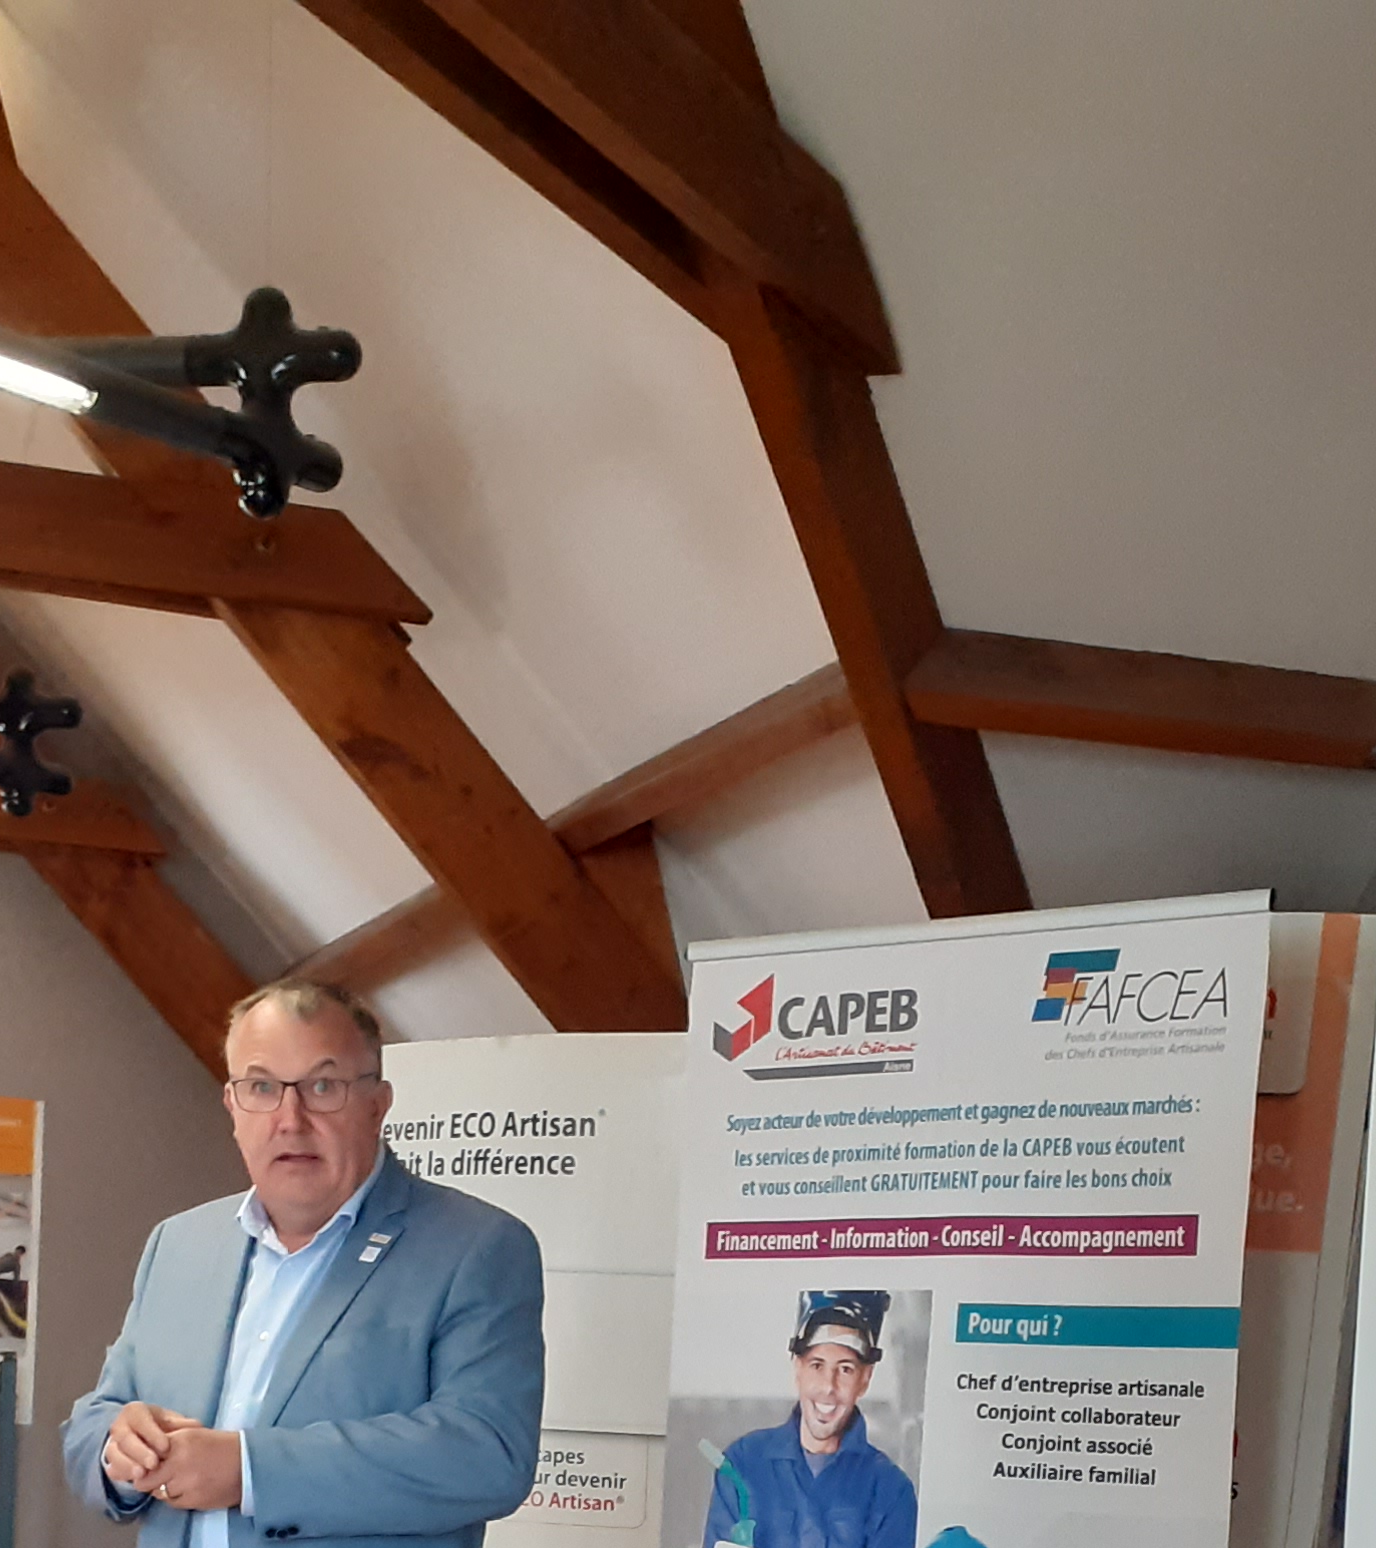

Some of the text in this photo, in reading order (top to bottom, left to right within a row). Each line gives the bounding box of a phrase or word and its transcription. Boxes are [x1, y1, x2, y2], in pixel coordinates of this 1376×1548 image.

[1064, 967, 1227, 1026] FAFCEA
[778, 989, 919, 1040] CAPEB
[1168, 1026, 1226, 1038] Formation
[1168, 1042, 1225, 1054] Artisanale
[383, 1112, 496, 1143] evenir ECO
[727, 1095, 1193, 1135] Soyez acteur de votre développement et gagnez de nouveaux marchés
[427, 1150, 445, 1176] la
[451, 1148, 576, 1176] différence
[735, 1136, 1185, 1167] les services de proximité formation de la CAPEB vous écoutent
[741, 1167, 1173, 1196] et vous conseillent GRATUITEMENT pour faire les bons choix
[717, 1224, 1186, 1253] Financement Information Conseil Accompagnement
[968, 1311, 1048, 1342] Pour qui
[956, 1373, 998, 1391] Chef
[1117, 1379, 1205, 1399] artisanale
[976, 1403, 1181, 1428] Conjoint collaborateur
[538, 1450, 586, 1467] tapes
[1001, 1433, 1153, 1456] Conjoint associé
[555, 1469, 628, 1490] devenir
[992, 1461, 1156, 1486] Auxiliaire familial
